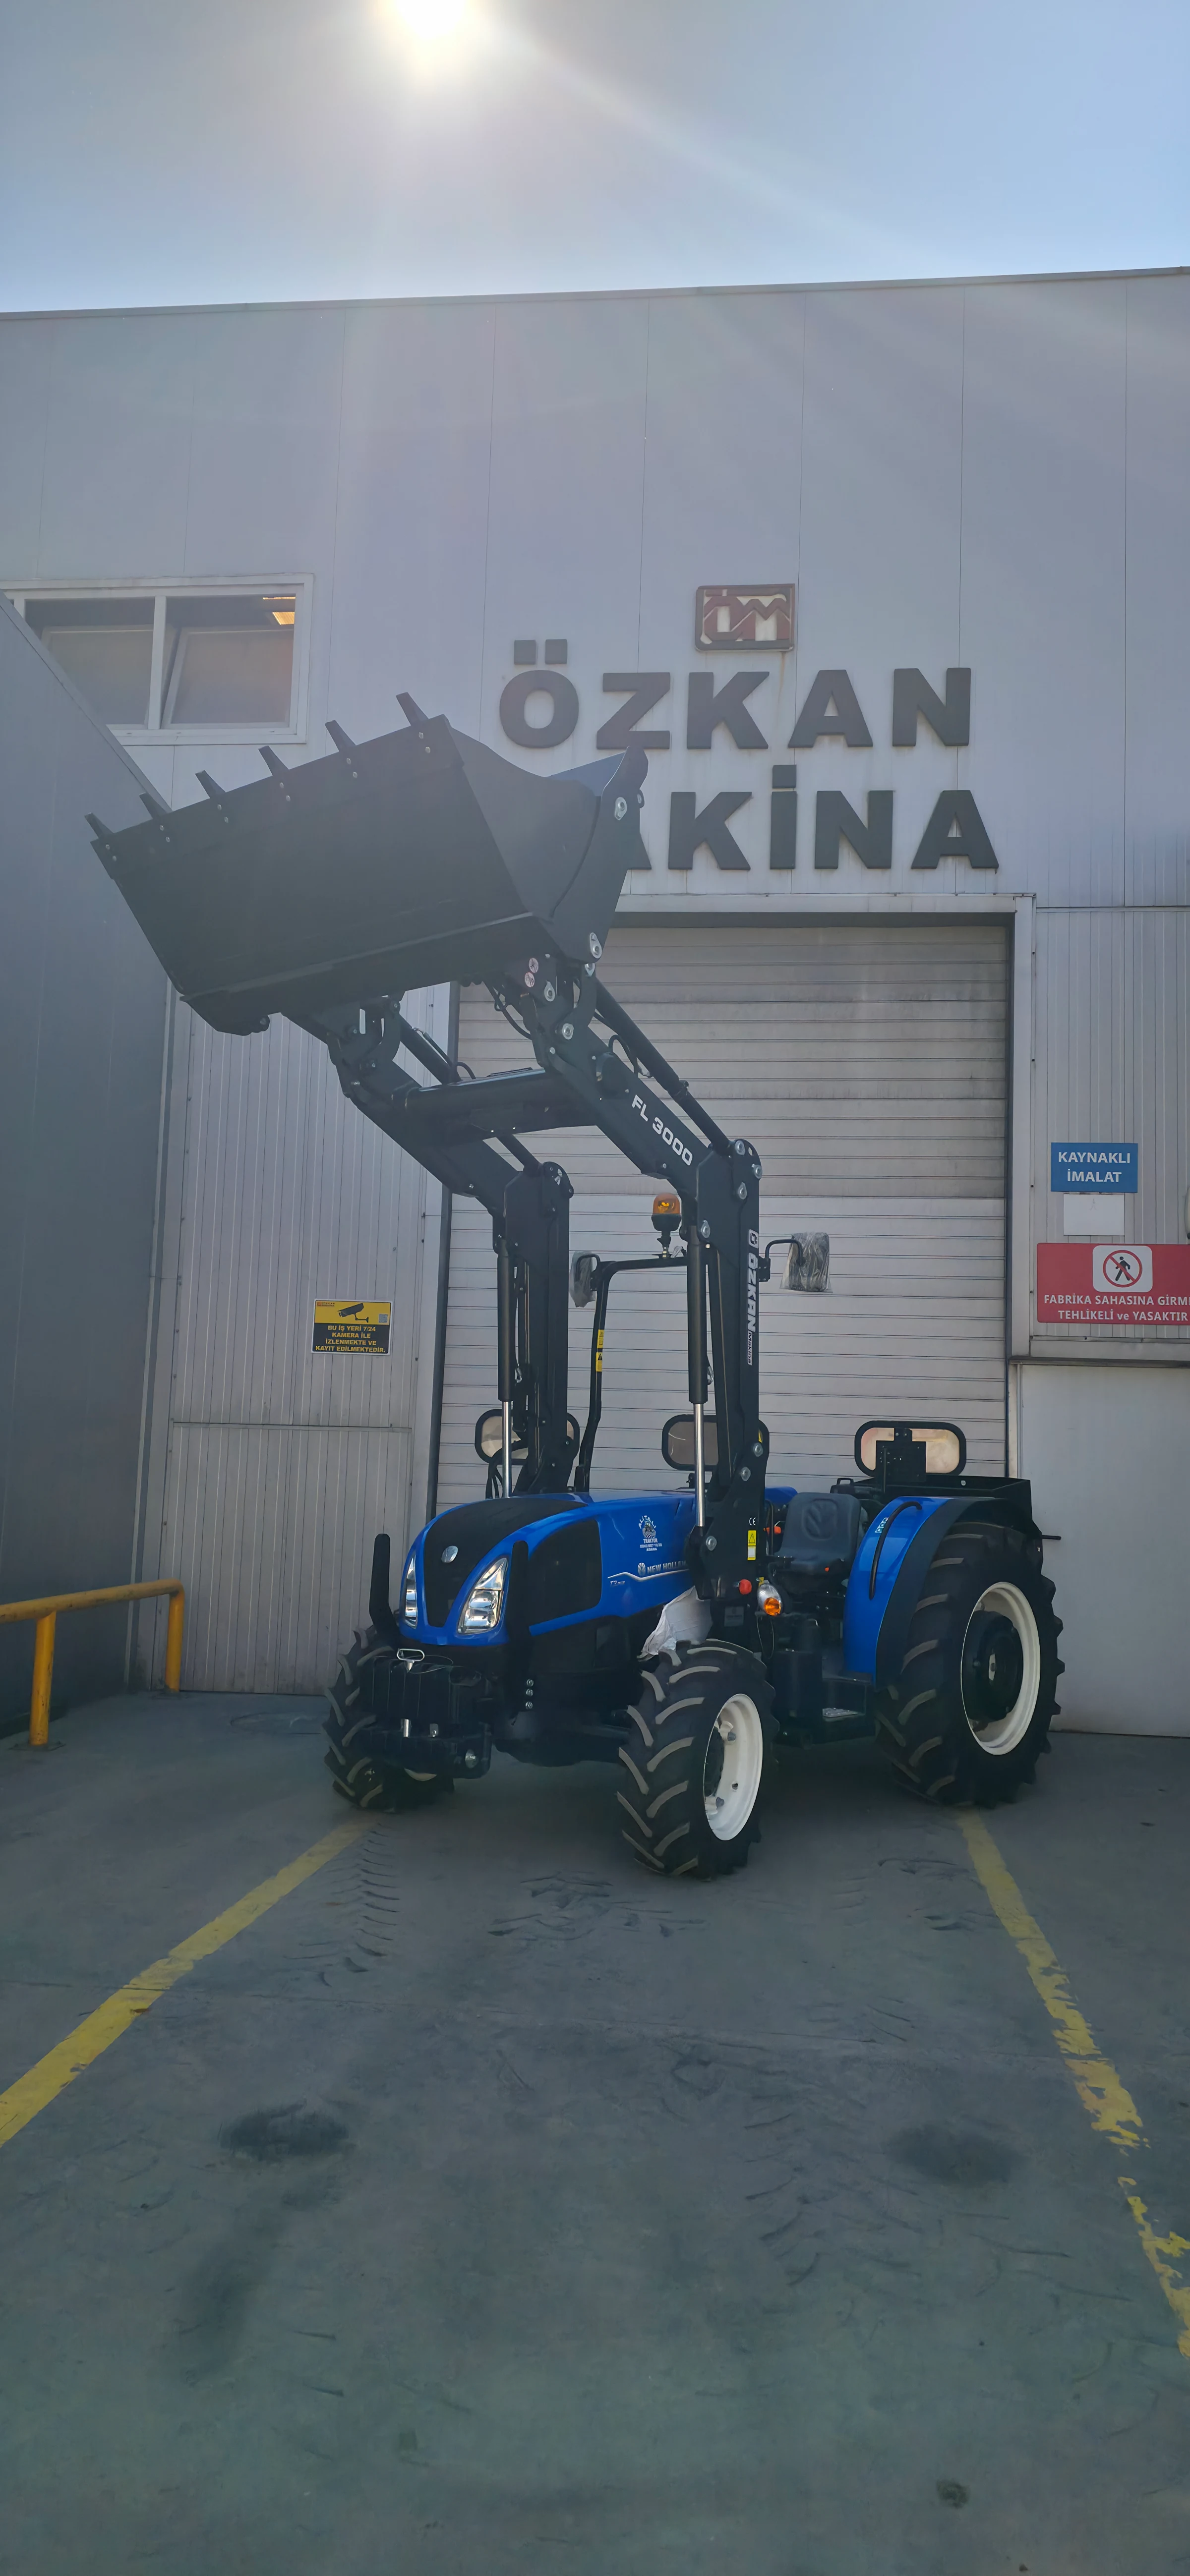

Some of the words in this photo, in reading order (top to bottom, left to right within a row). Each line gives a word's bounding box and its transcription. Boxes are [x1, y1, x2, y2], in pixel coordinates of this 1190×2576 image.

[499, 639, 971, 749] ÖZKAN
[628, 764, 999, 870] KİNA
[632, 1094, 649, 1122] FL
[652, 1117, 693, 1166] 3000
[1058, 1152, 1130, 1164] KAYNAKLI
[1068, 1168, 1122, 1183] İMALAT
[1044, 1293, 1092, 1305] FABRİKA
[1095, 1294, 1154, 1306] SAHASINA
[1157, 1294, 1190, 1306] GİRM
[1058, 1309, 1114, 1320] TEHLİKELİ
[1133, 1312, 1188, 1321] YASAKTIR
[647, 1564, 661, 1574] NEW
[663, 1560, 687, 1570] HOLLAN
